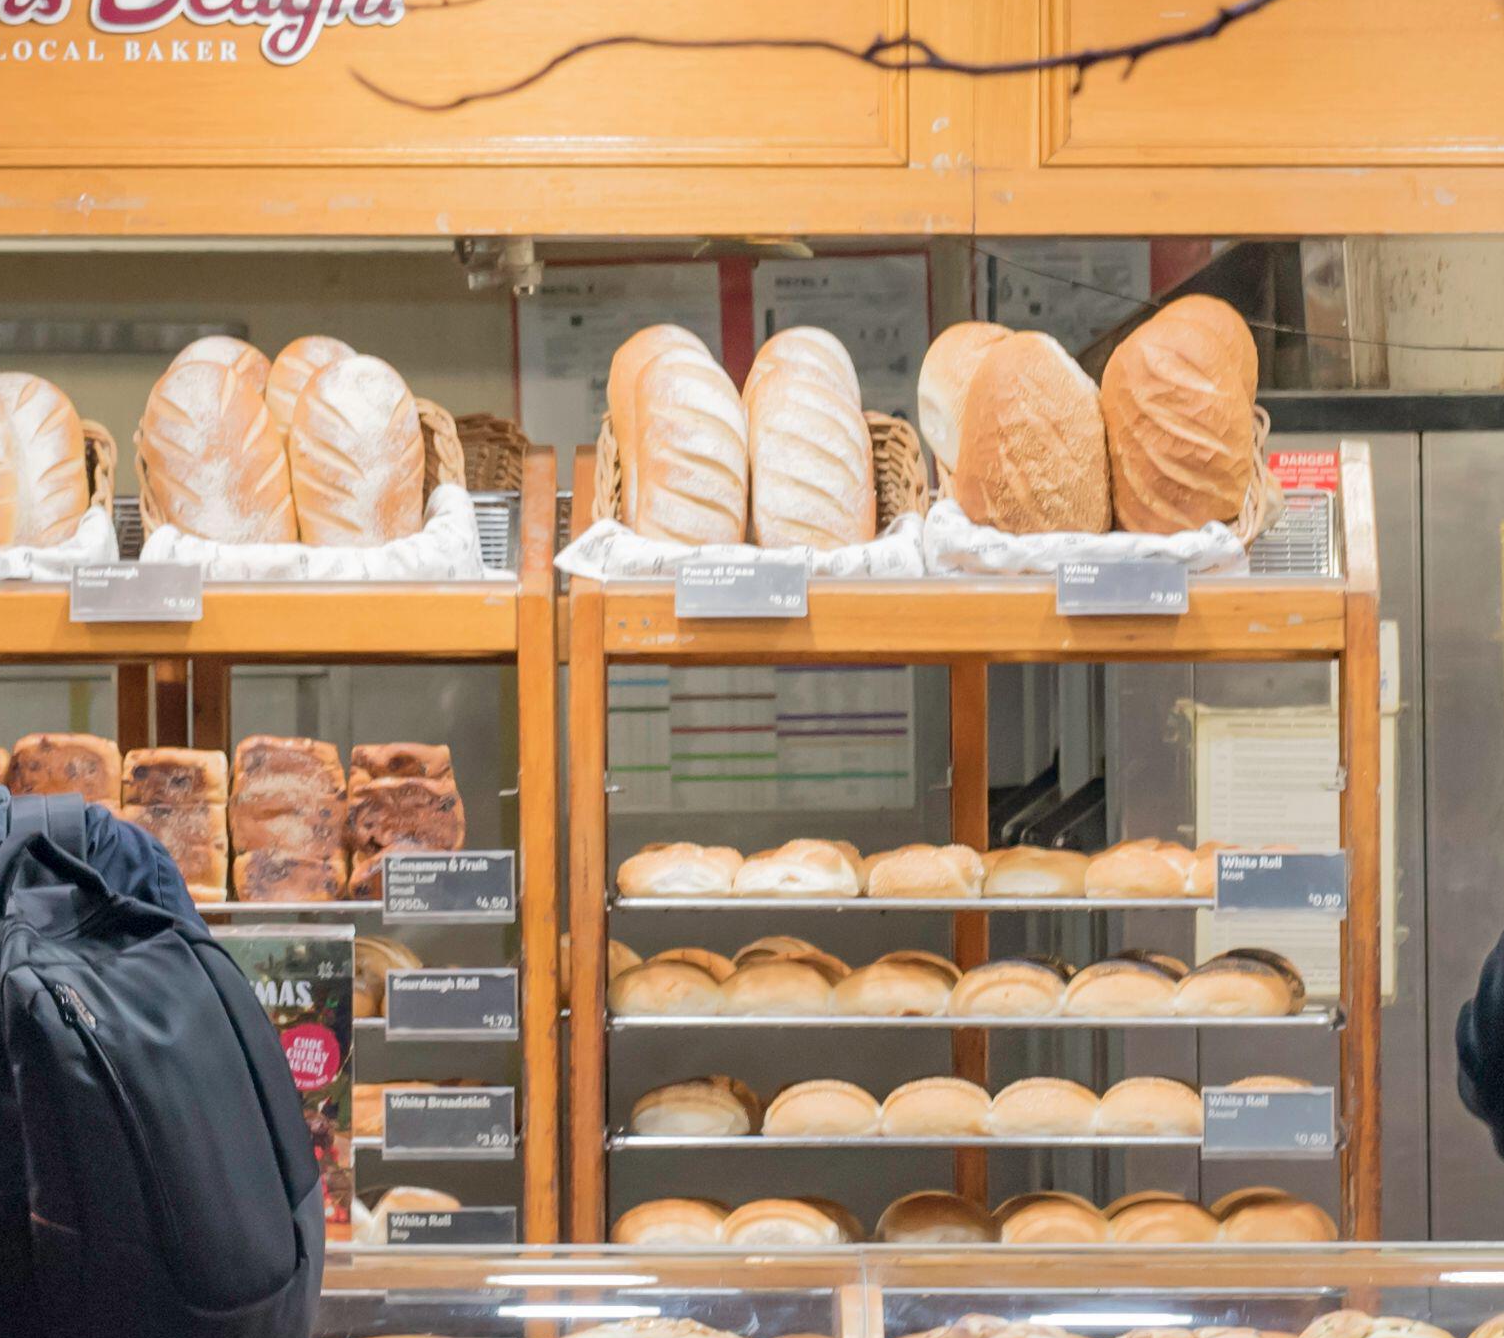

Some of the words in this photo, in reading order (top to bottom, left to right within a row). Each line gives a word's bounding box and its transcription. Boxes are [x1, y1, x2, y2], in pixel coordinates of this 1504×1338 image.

[124, 39, 238, 61] BAKER
[1279, 453, 1334, 467] DANGER
[77, 567, 139, 579] Sourdough
[682, 567, 710, 577] Pane
[726, 567, 755, 577] Casa
[1063, 564, 1100, 575] White
[389, 859, 446, 872] Cinnamon
[459, 859, 488, 871] Fruit
[1221, 856, 1258, 869] White
[1259, 856, 1282, 869] Roll
[417, 873, 437, 884] Loaf
[393, 978, 456, 993] Sourdough
[457, 977, 479, 990] Roll
[255, 981, 313, 1006] MAS
[293, 1037, 324, 1048] CHOC
[287, 1048, 329, 1062] CHERRY
[390, 1096, 426, 1109] White
[427, 1095, 490, 1109] Breadstick
[1208, 1095, 1244, 1107] White
[1246, 1095, 1269, 1107] Roll
[391, 1215, 425, 1228] White
[427, 1214, 451, 1227] Roll
